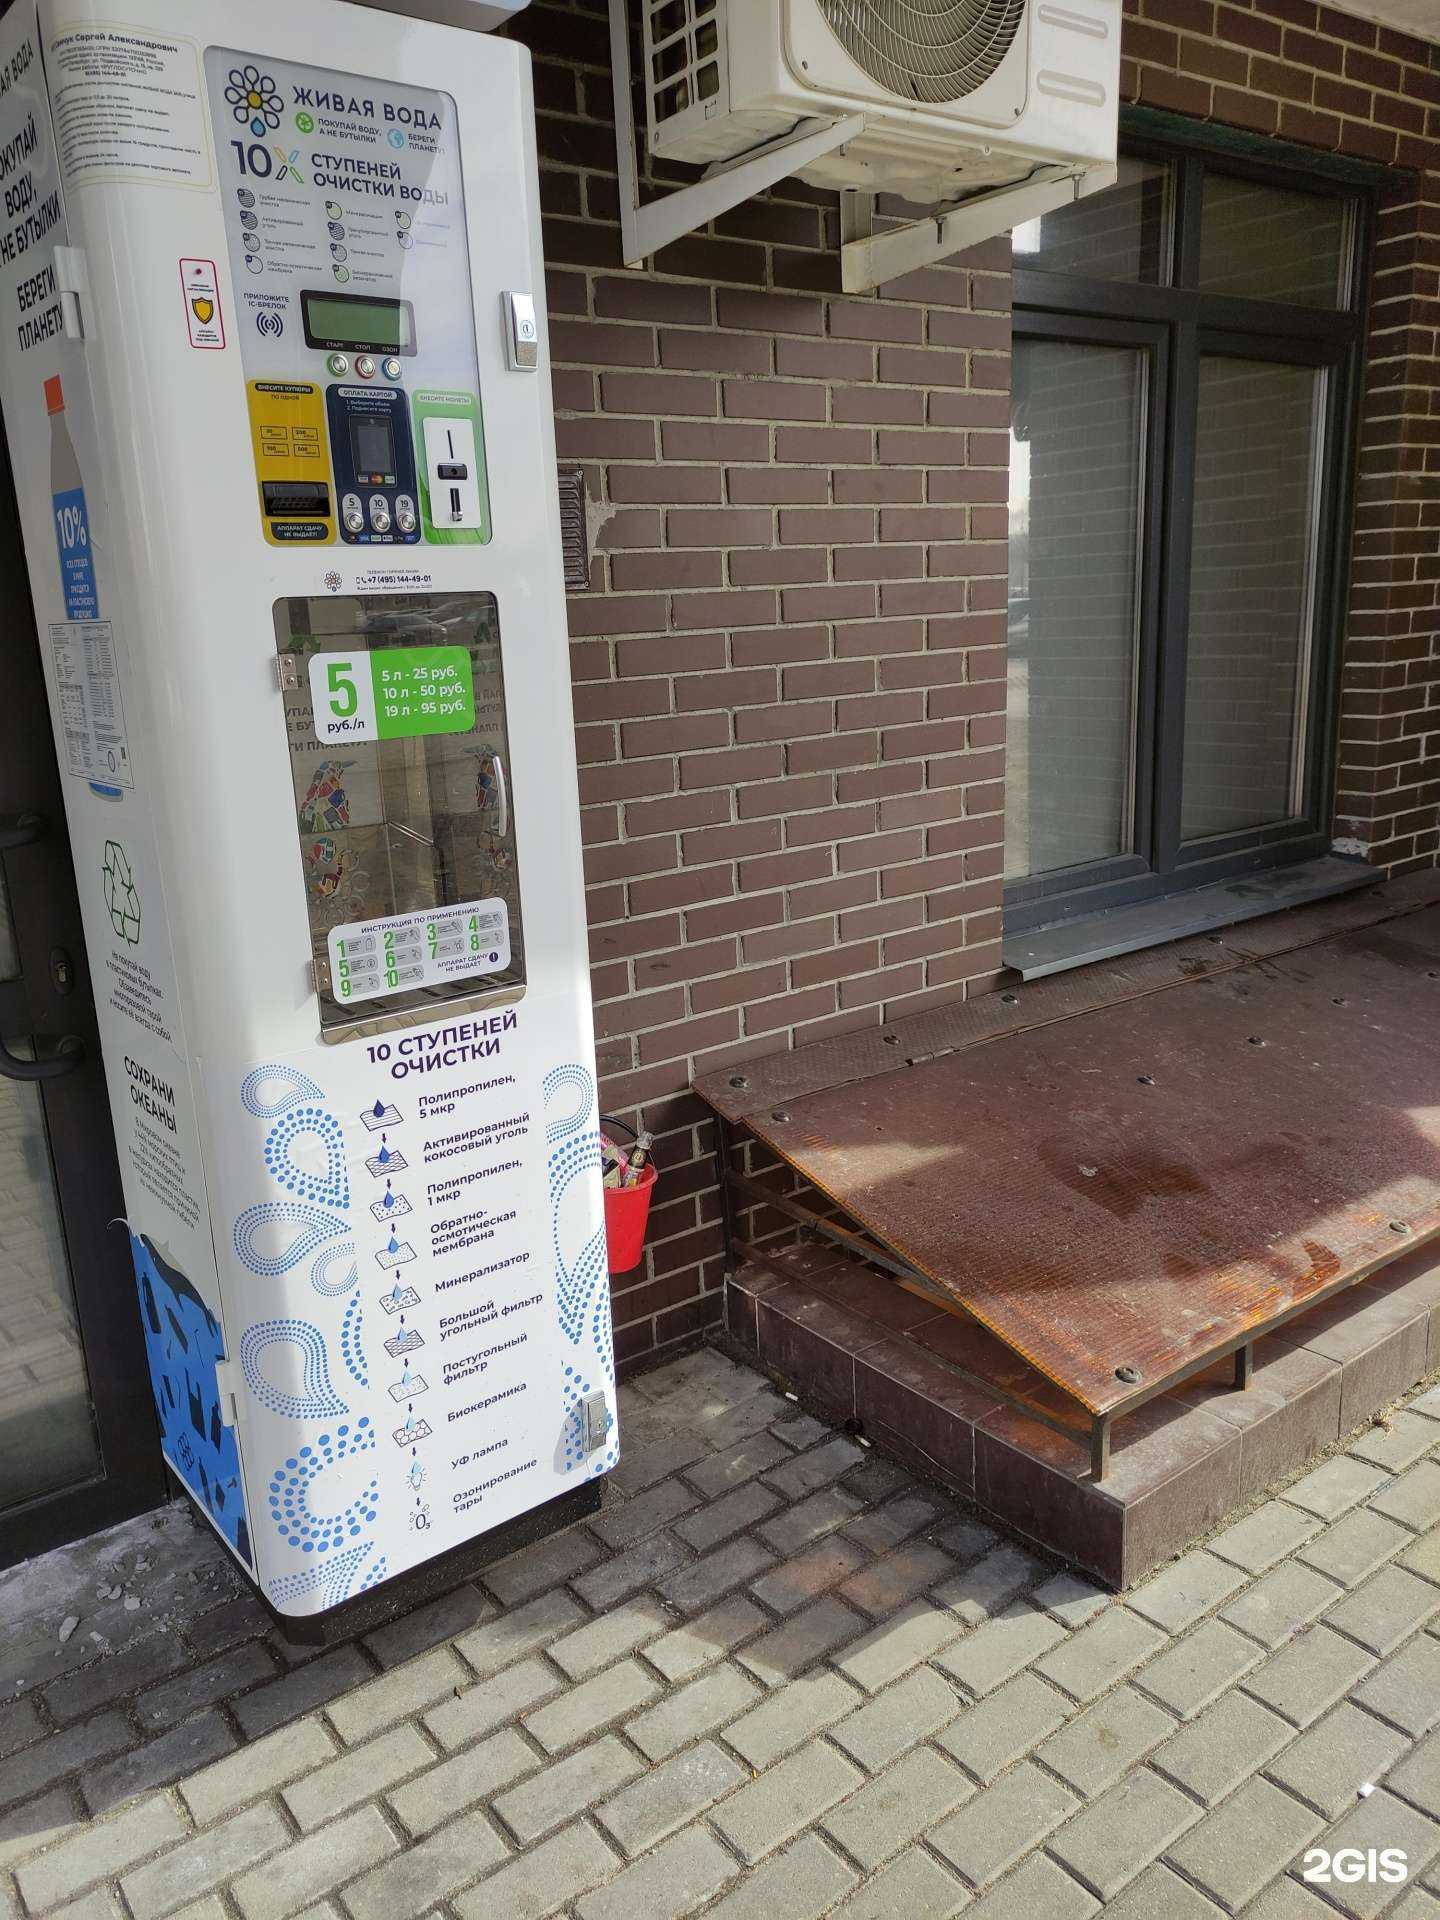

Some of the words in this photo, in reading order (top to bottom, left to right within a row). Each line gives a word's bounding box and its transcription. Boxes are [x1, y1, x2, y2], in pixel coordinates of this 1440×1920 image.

[11, 38, 34, 82] ВОДА
[108, 34, 178, 53] Александрович
[293, 85, 375, 119] ЖИВАЯ
[383, 102, 442, 131] ВОДА
[318, 118, 357, 133] ПОКУПАЙ
[358, 125, 382, 137] ВОДУ,
[319, 127, 325, 135] А
[327, 128, 338, 138] НЕ
[339, 131, 377, 144] БУТЫЛКИ
[408, 133, 436, 145] БЕРЕГИ
[311, 152, 402, 181] СТУПЕНЕЙ
[4, 171, 37, 218] ВОДУ,
[313, 172, 396, 198] ОЧИСТКИ
[400, 184, 449, 206] ВОДЫ
[15, 190, 61, 254] БУТЫЛКИ
[16, 264, 56, 313] БЕРЕГИ
[243, 292, 289, 303] ПРИЛОЖИТЕ
[326, 341, 344, 349] СТАРТ
[349, 497, 356, 507] 5
[373, 499, 384, 508] 10
[400, 500, 410, 508] 19
[56, 505, 87, 549] 10%
[378, 575, 396, 585] (495)
[397, 574, 432, 583] 144-49-01
[381, 670, 391, 682] 5
[393, 671, 402, 681] л
[412, 667, 428, 679] 25
[431, 664, 458, 682] руб.
[326, 662, 358, 719] 5
[383, 687, 398, 700] 10
[400, 688, 409, 698] л
[420, 684, 437, 696] 50
[439, 681, 466, 699] руб.
[384, 705, 400, 717] 19
[401, 705, 411, 716] л
[421, 702, 438, 714] 95
[440, 699, 466, 716] руб.
[327, 717, 365, 734] руб./л
[337, 940, 345, 958] 1
[384, 931, 394, 949] 2
[427, 923, 437, 941] 3
[468, 915, 479, 932] 4
[361, 918, 412, 934] ИНСТРУКЦИЯ
[414, 915, 425, 924] ПО
[426, 907, 480, 921] ПРИМЕНЕНИЮ
[338, 960, 350, 977] 5
[386, 951, 395, 968] 6
[429, 942, 438, 959] 7
[470, 934, 480, 951] 8
[437, 957, 467, 968] АППАРАТ
[467, 952, 488, 961] СДАЧУ
[455, 961, 481, 971] ВЫДАЕТ
[340, 979, 351, 997] 9
[384, 970, 399, 988] 10
[367, 1043, 392, 1064] 10
[397, 1009, 519, 1056] СТУПЕНЕЙ
[391, 1038, 501, 1080] ОЧИСТКИ
[124, 1055, 176, 1107] СОХРАНИ
[418, 1073, 517, 1108] Полипропилен,
[130, 1085, 177, 1135] ОКЕАНЫ
[419, 1109, 427, 1119] 5
[430, 1102, 455, 1118] мкр
[423, 1112, 531, 1152] Активированный
[424, 1137, 492, 1164] кокосовый
[495, 1126, 528, 1145] уголь
[427, 1160, 523, 1195] Полипропилен,
[427, 1198, 433, 1206] 1
[436, 1190, 461, 1207] мкр
[430, 1209, 488, 1235] Обратно-
[431, 1211, 517, 1246] осмотическая
[432, 1229, 495, 1257] мембрана
[435, 1252, 530, 1293] Минерализатор
[439, 1301, 495, 1329] Большой
[440, 1311, 498, 1342] угольный
[500, 1294, 543, 1317] фильтр
[443, 1333, 528, 1375] Постугольный
[443, 1362, 488, 1386] фильтр
[447, 1383, 527, 1423] Биокерамика
[451, 1456, 470, 1471] УФ
[473, 1438, 509, 1460] лампа
[453, 1459, 538, 1504] Озонирование
[454, 1496, 483, 1514] тары
